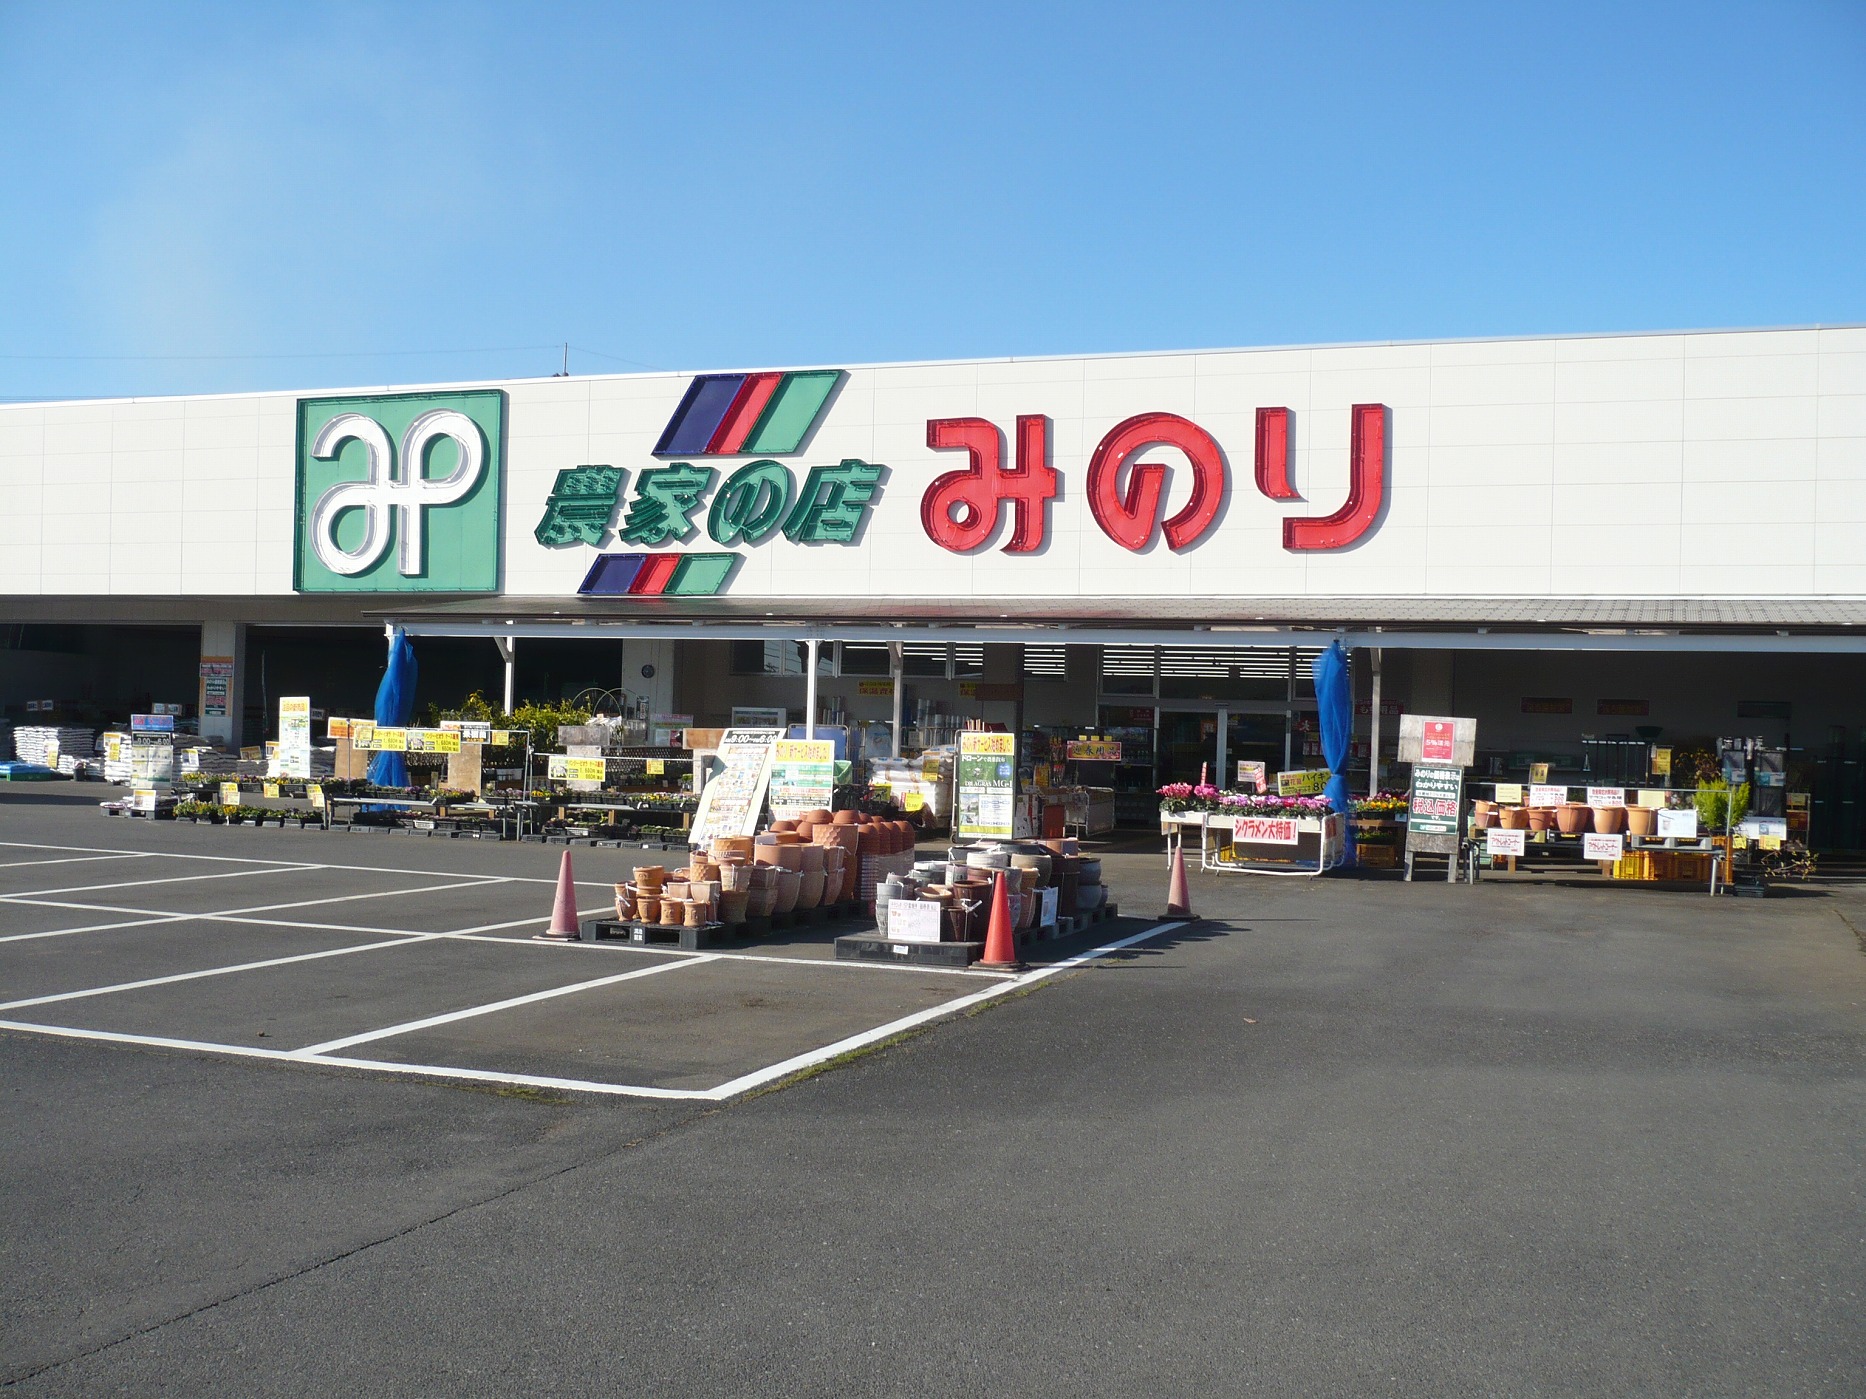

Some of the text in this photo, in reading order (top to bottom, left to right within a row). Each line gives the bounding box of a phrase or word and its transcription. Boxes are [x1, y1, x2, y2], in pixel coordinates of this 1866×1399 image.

[920, 403, 1384, 553] みのり
[534, 459, 885, 548] 農家の店
[1415, 780, 1458, 790] わかりやすい
[1413, 797, 1458, 816] 税込価格
[1235, 820, 1297, 840] シクラメン大特価!
